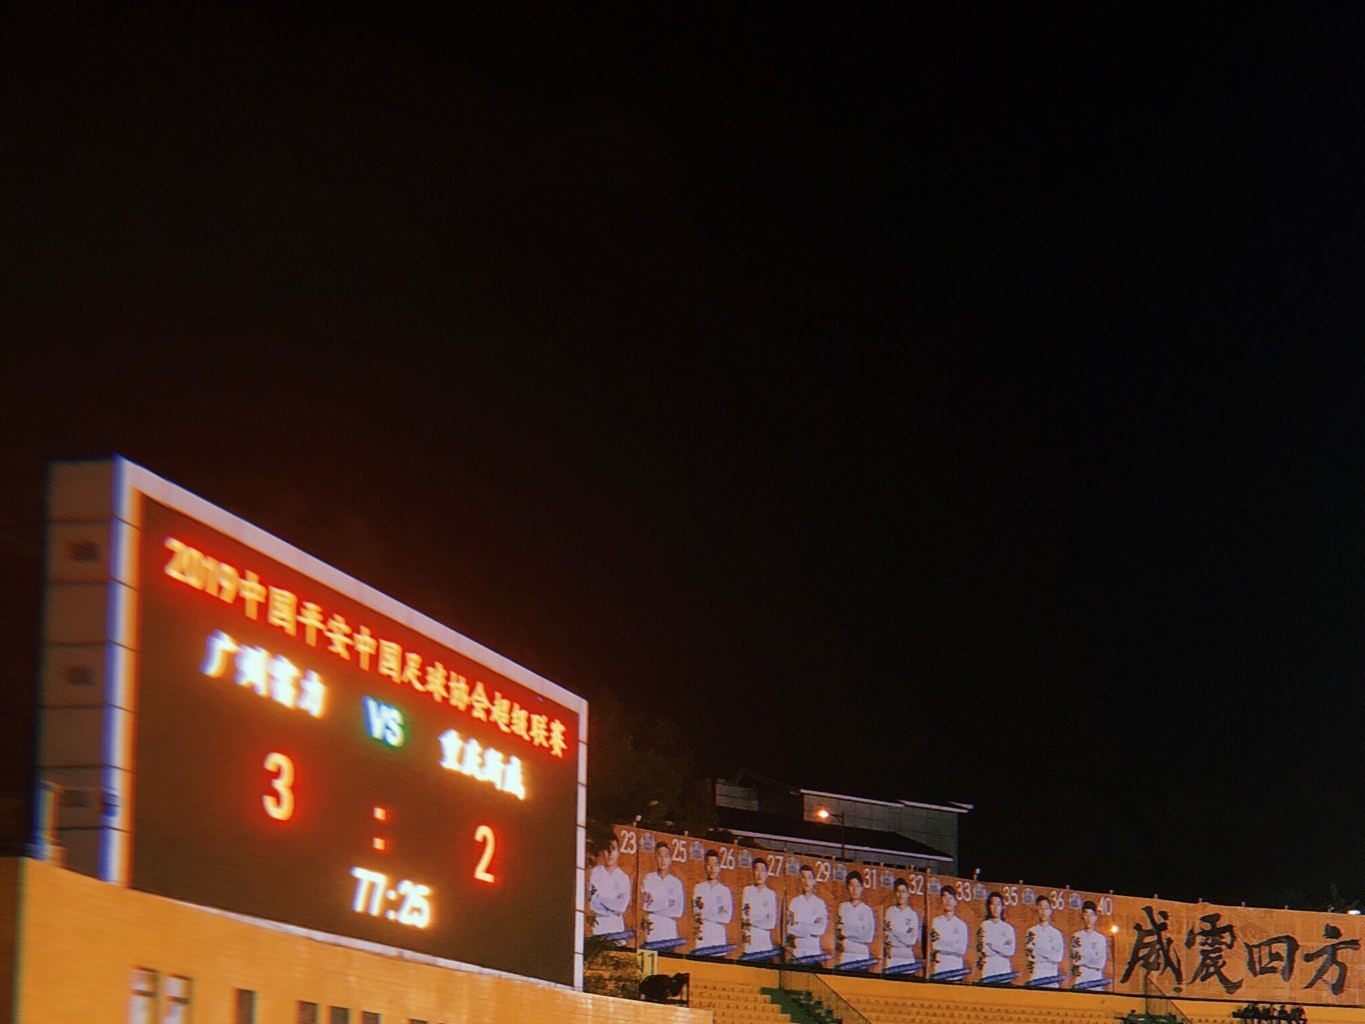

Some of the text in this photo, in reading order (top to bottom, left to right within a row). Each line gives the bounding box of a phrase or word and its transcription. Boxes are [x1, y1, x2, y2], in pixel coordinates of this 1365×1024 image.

[164, 536, 568, 758] 2019中国平安中国足球协会超级联赛
[362, 695, 405, 748] VS
[262, 752, 295, 821] 3
[473, 825, 496, 883] 2
[620, 830, 637, 854] 23
[672, 839, 688, 863] 25
[720, 847, 736, 870] 26
[768, 855, 784, 877] 27
[816, 861, 831, 883] 29
[863, 868, 878, 889] 31
[908, 874, 924, 895] 32
[956, 881, 972, 902] 33
[350, 865, 433, 929] 77:25
[1003, 886, 1019, 906] 35
[1051, 890, 1065, 910] 36
[1097, 896, 1113, 916] 40
[638, 951, 656, 974] 11
